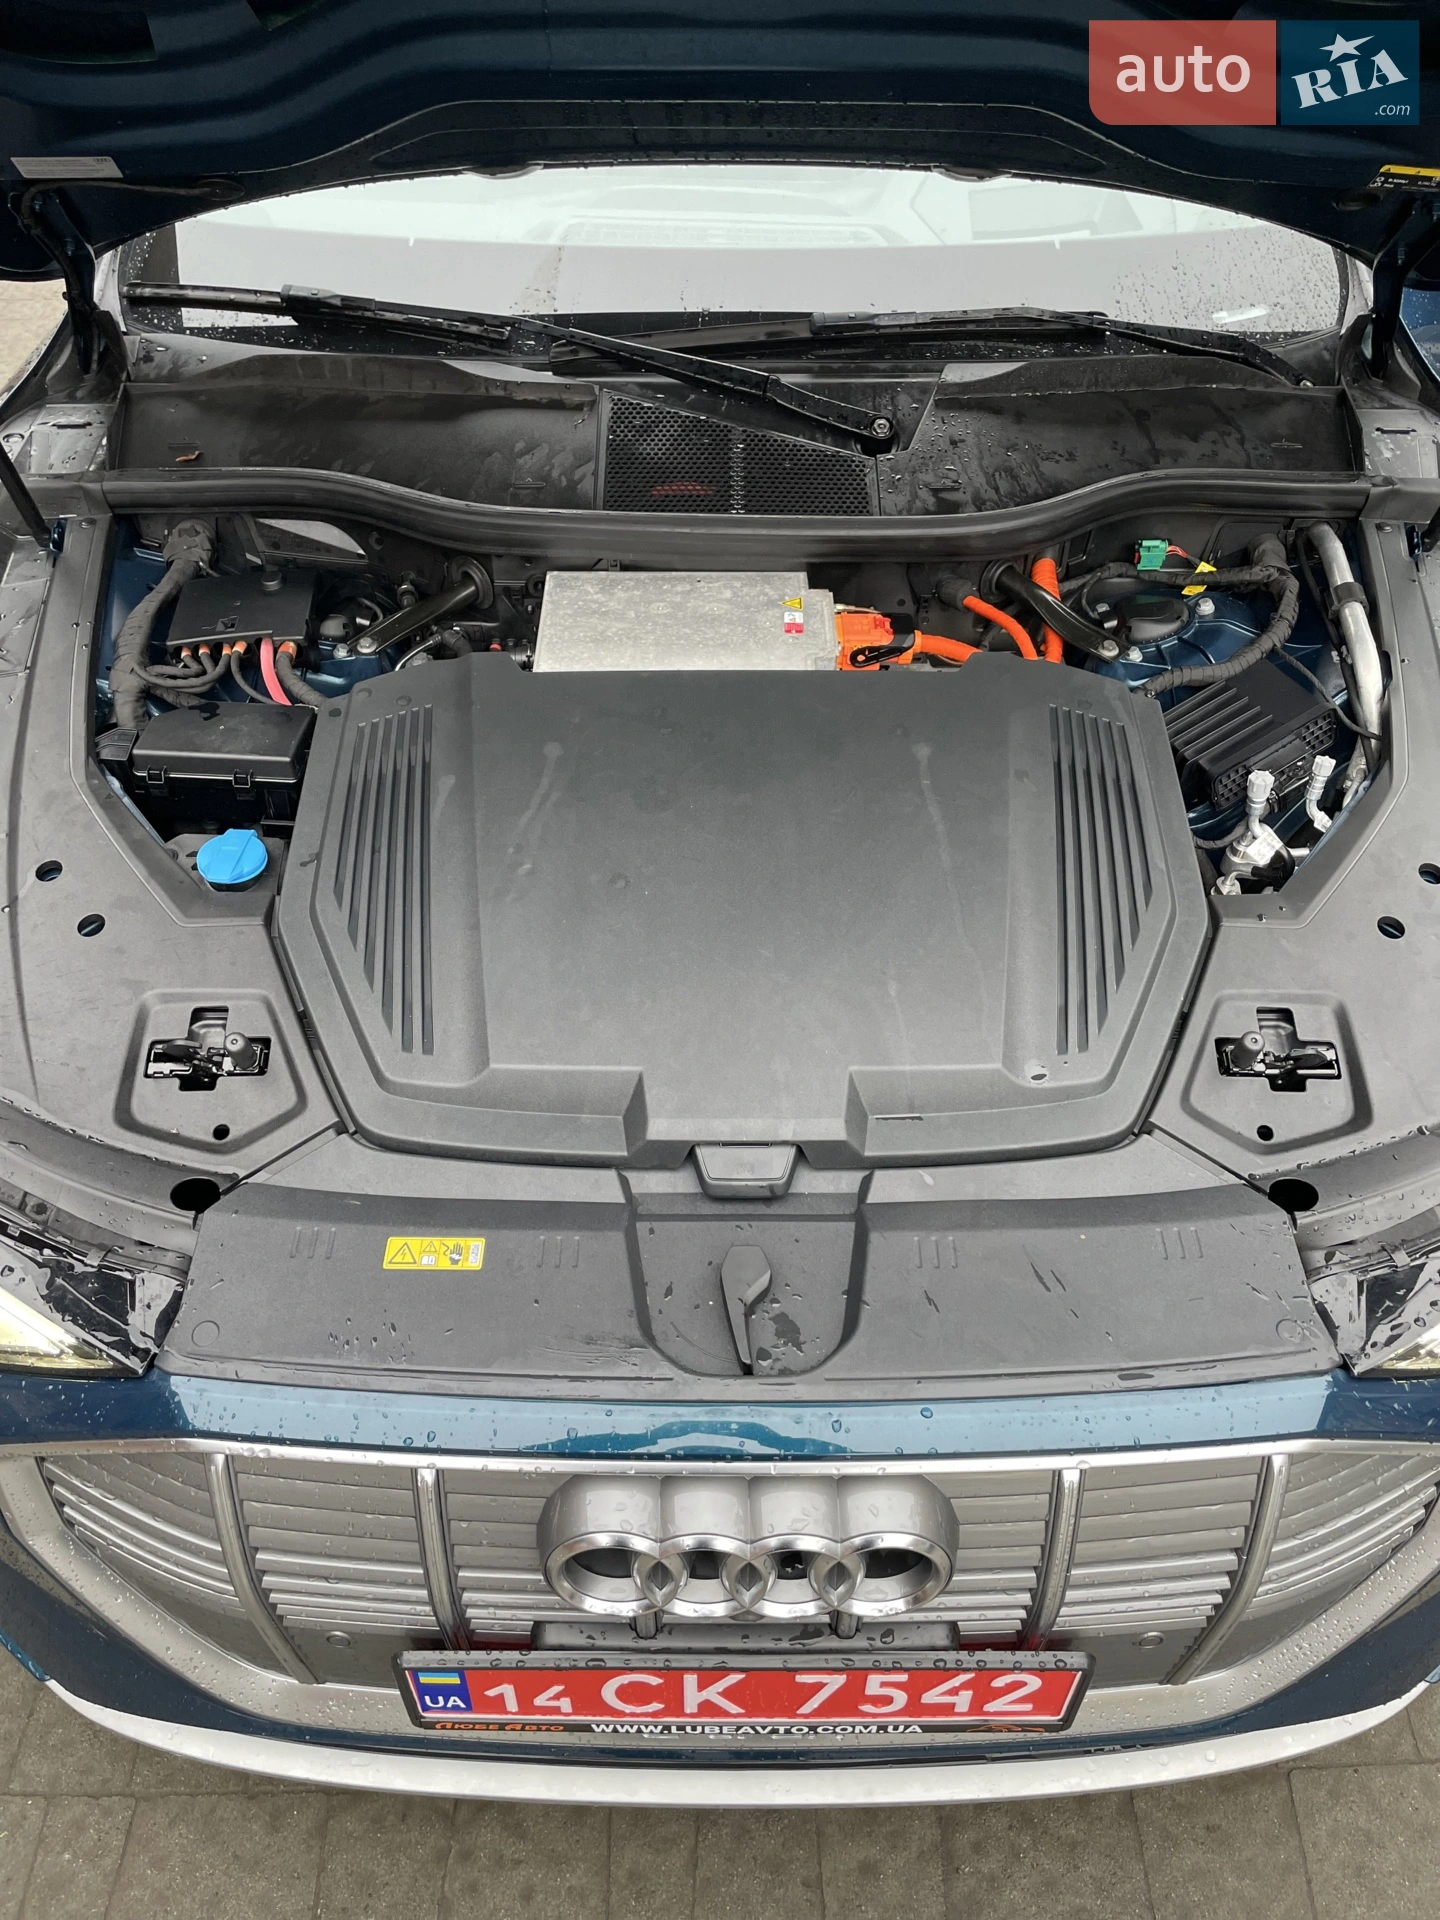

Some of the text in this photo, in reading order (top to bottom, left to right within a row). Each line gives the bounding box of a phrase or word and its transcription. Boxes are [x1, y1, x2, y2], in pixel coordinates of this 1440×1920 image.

[483, 1673, 1043, 1714] 14 CK 7542
[424, 1695, 467, 1709] UA
[591, 1723, 923, 1735] WWW.LUBEAVTO.COM.UA
